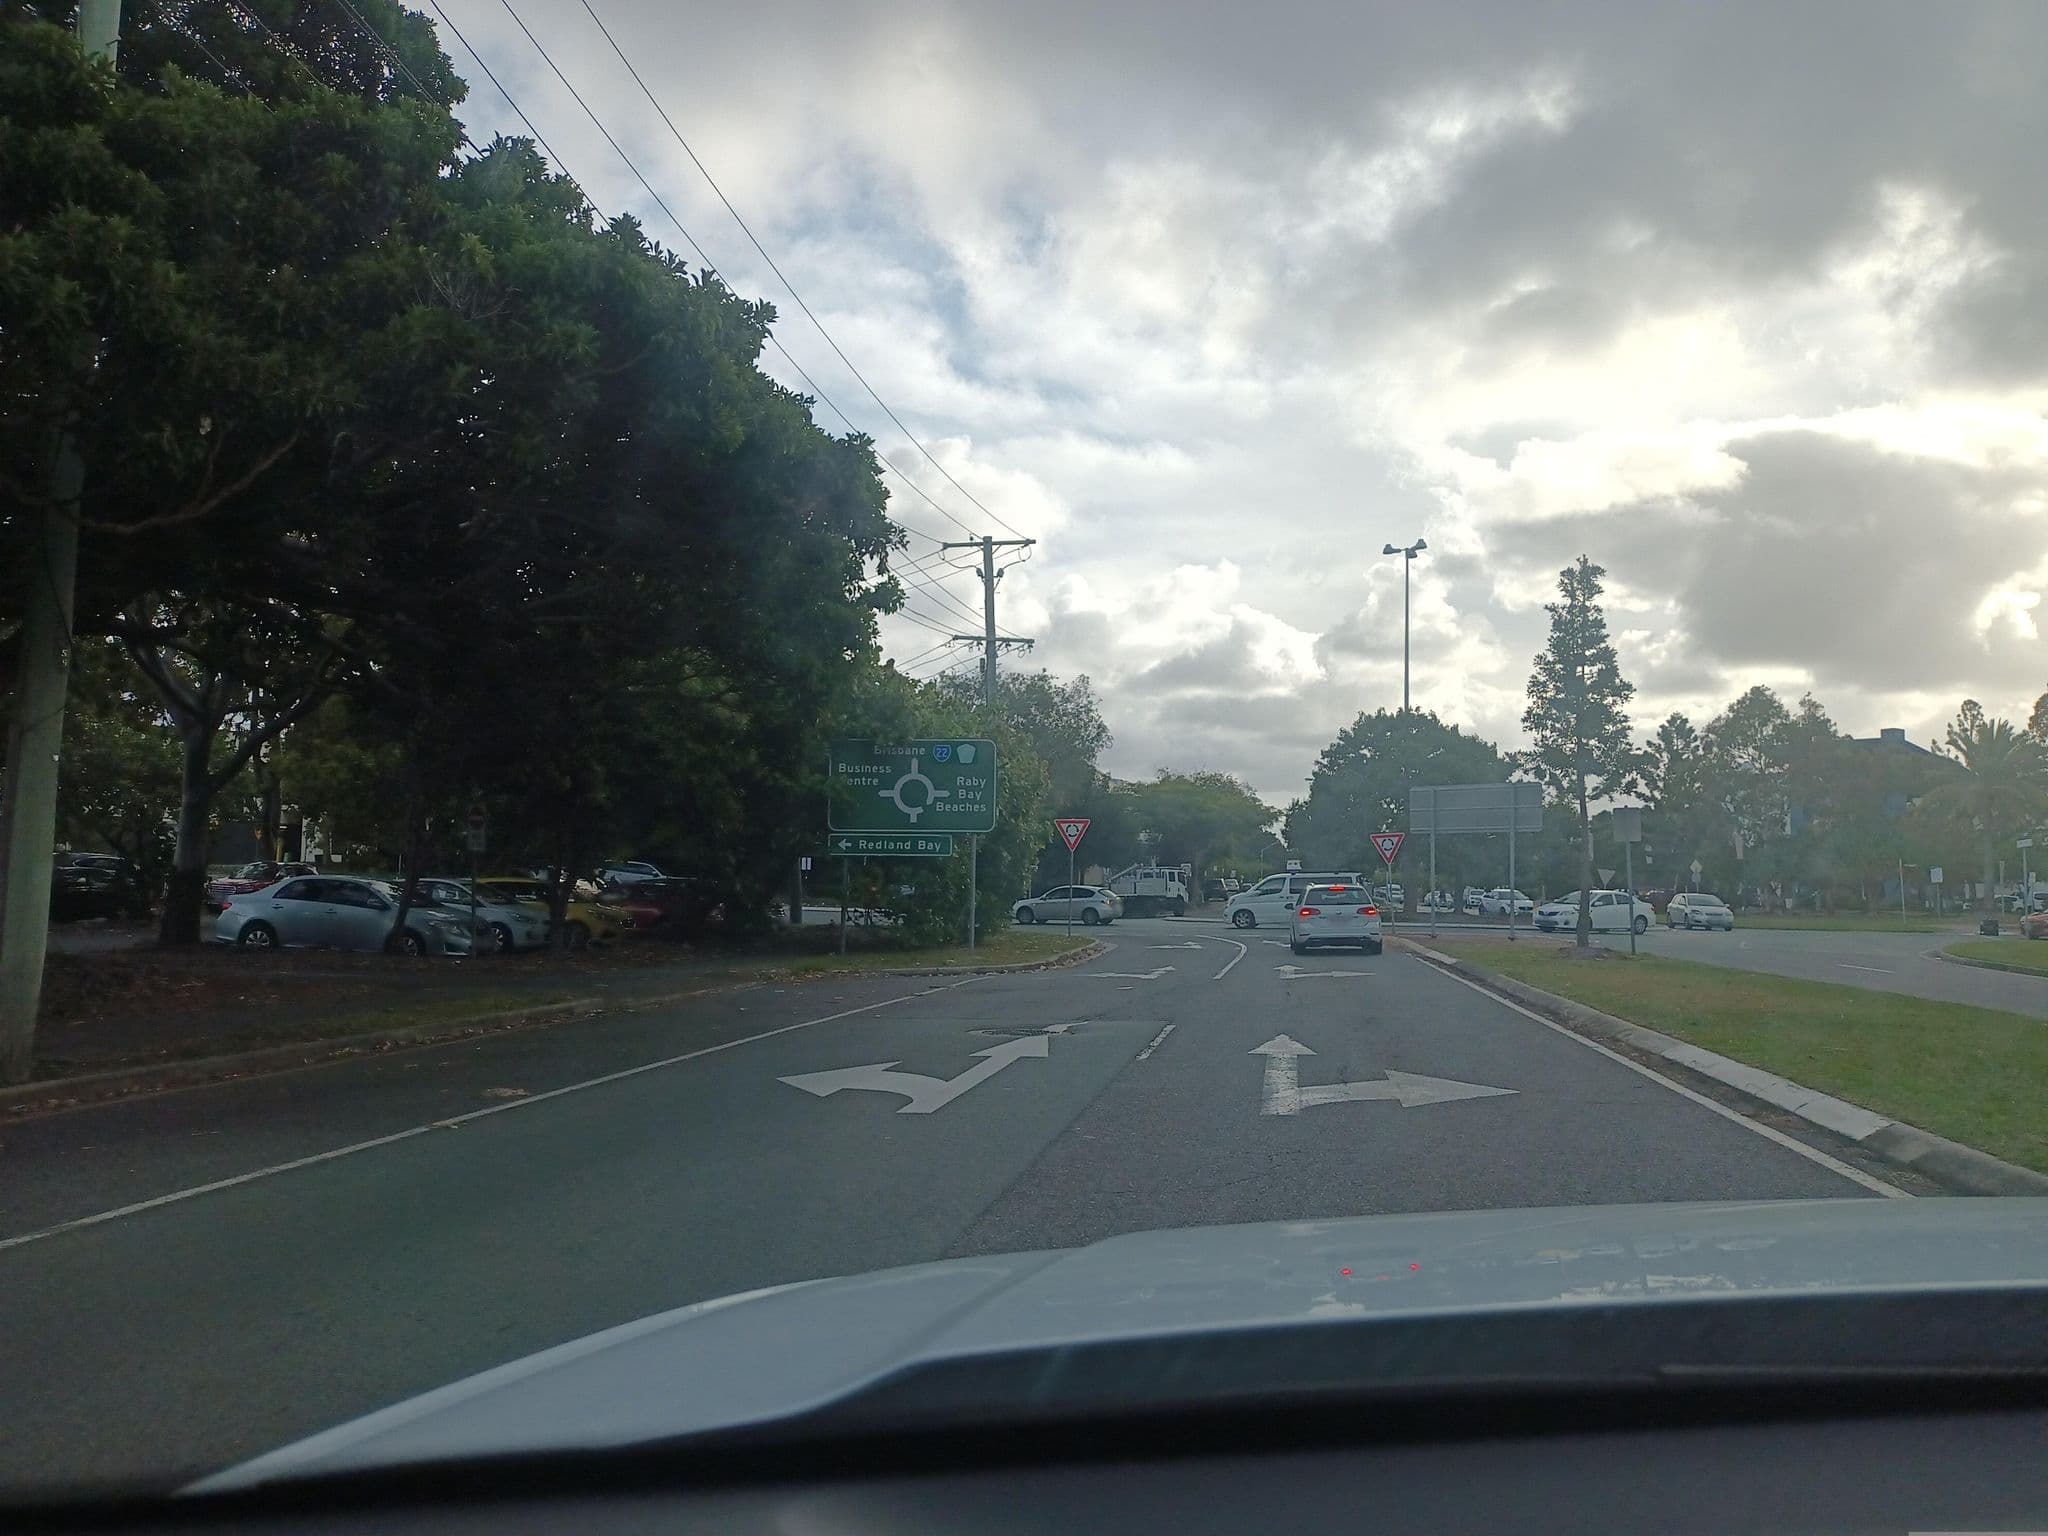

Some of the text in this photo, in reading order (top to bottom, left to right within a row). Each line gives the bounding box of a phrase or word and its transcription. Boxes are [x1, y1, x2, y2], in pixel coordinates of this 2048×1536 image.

[935, 747, 948, 758] 22
[838, 763, 892, 773] Business
[845, 776, 880, 786] entre
[956, 776, 986, 789] Raby
[958, 789, 982, 801] Bay
[936, 802, 986, 812] Beaches
[858, 840, 941, 852] Redland Bay
